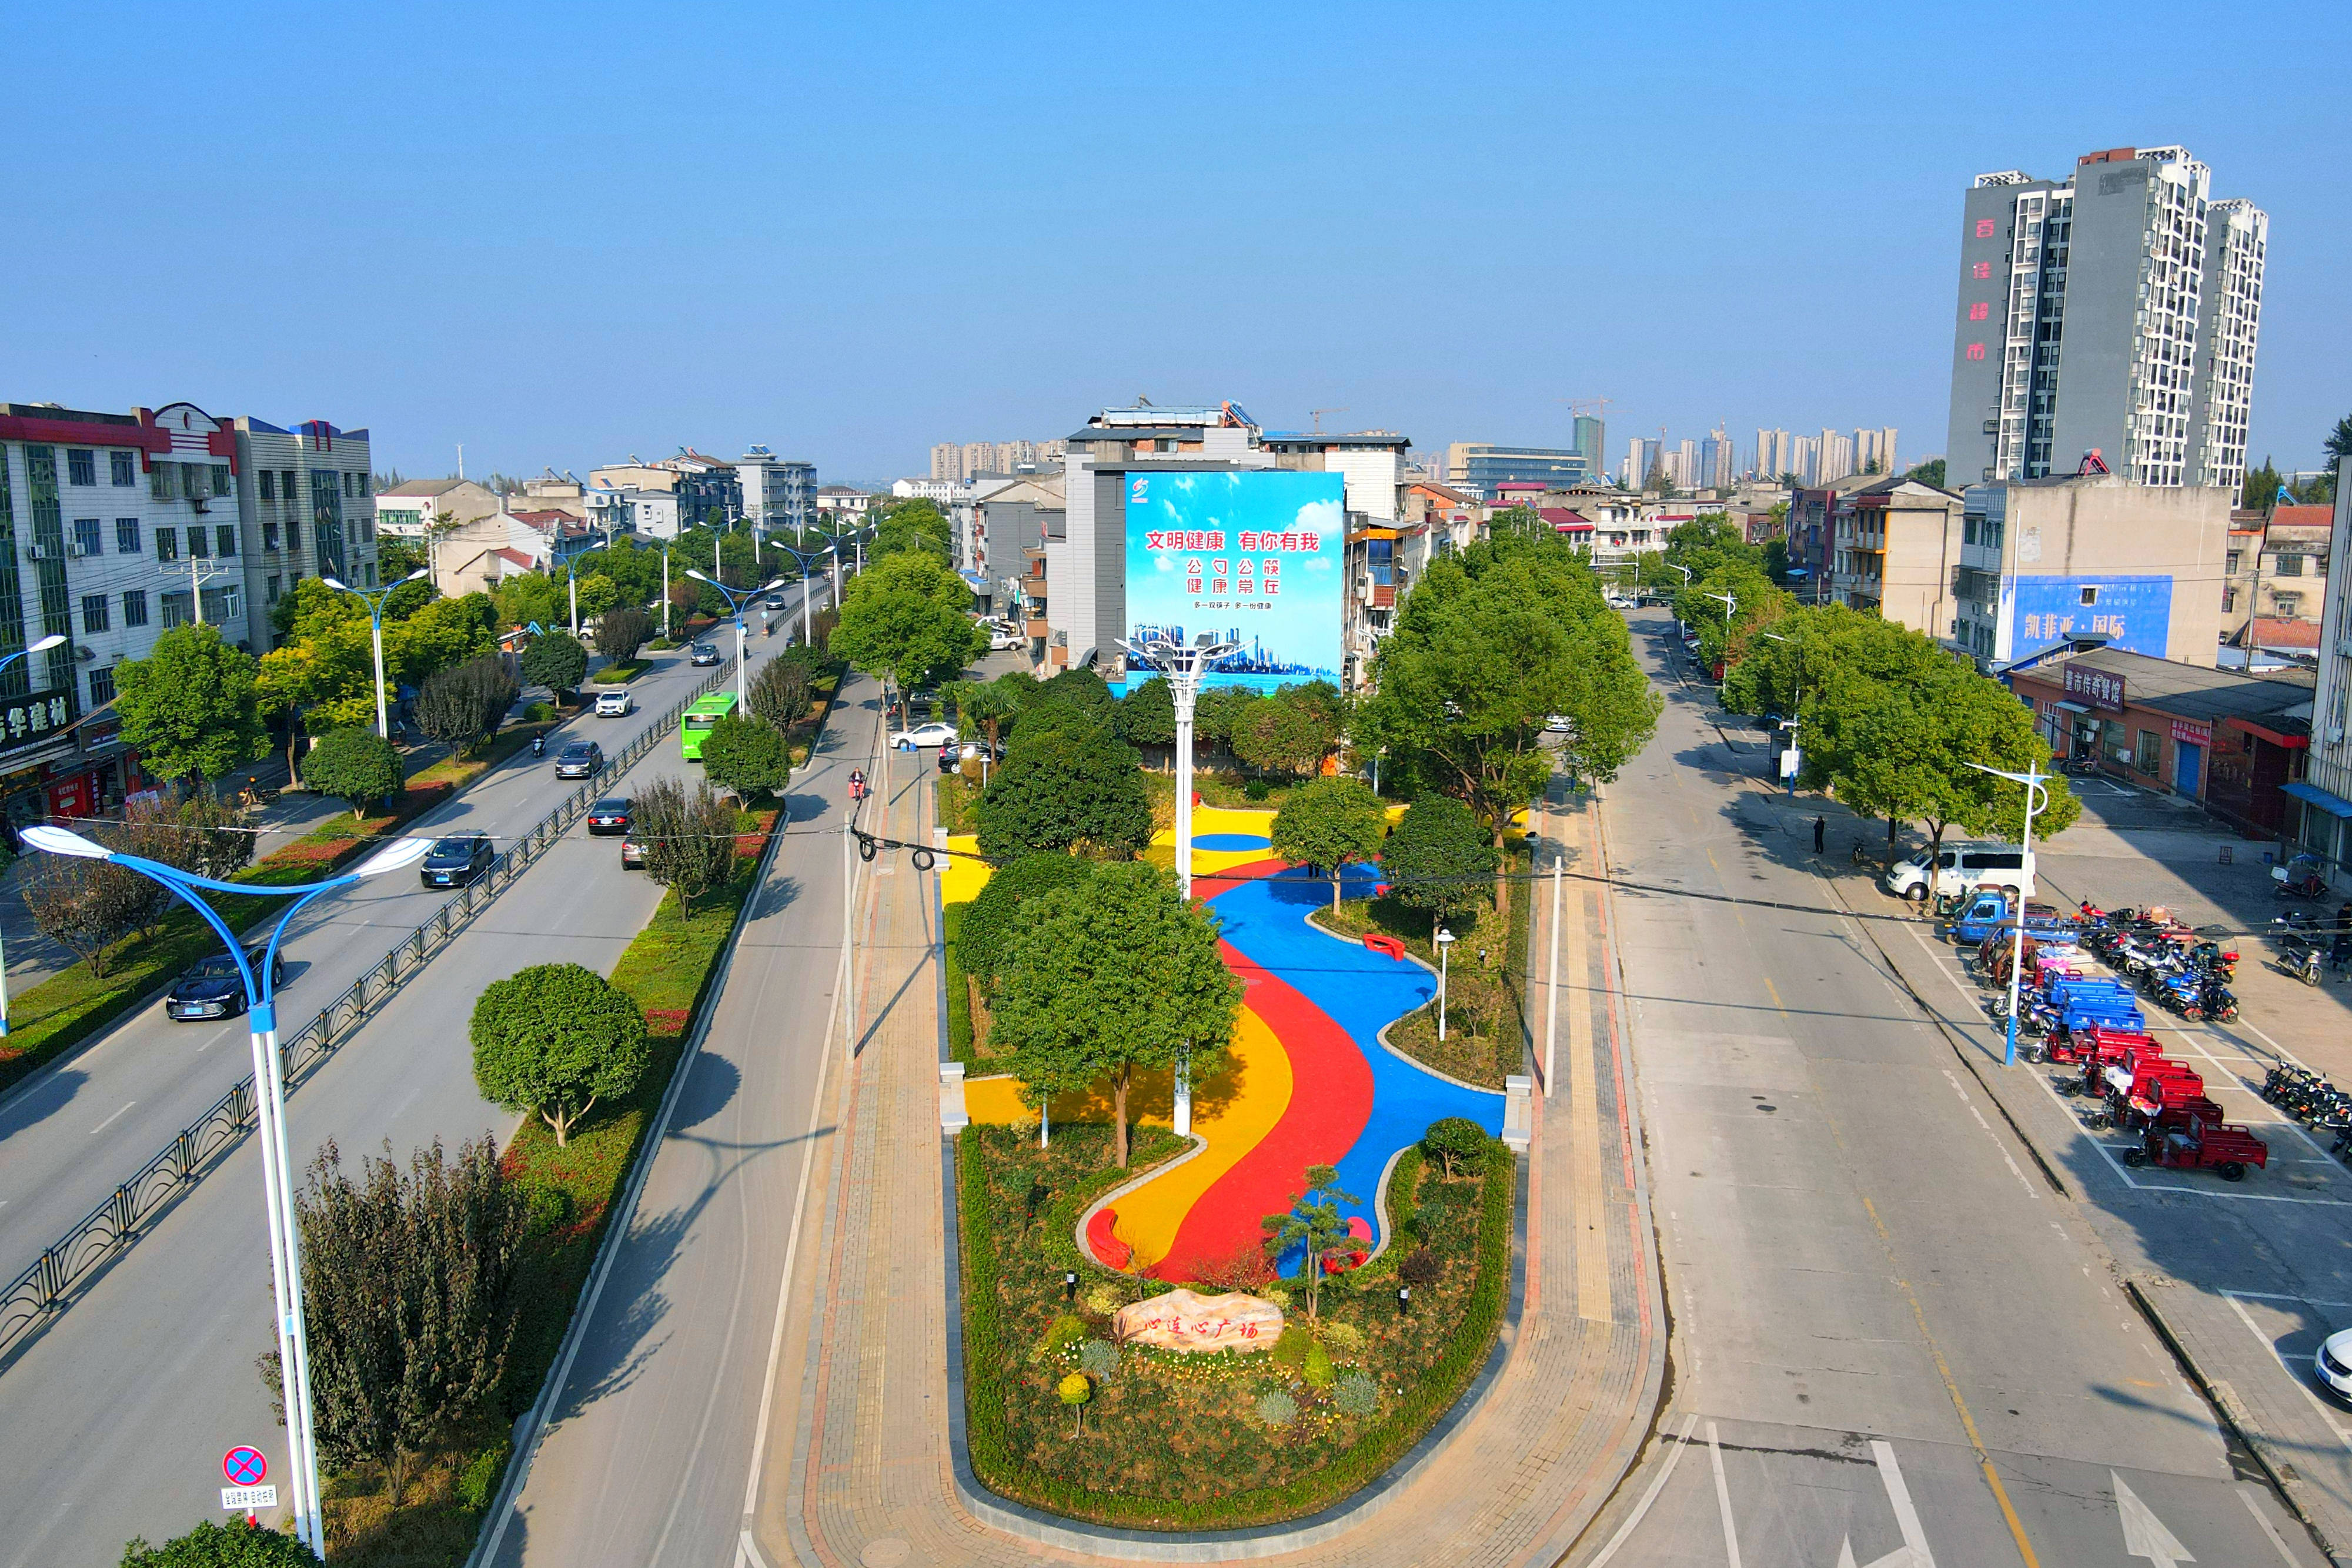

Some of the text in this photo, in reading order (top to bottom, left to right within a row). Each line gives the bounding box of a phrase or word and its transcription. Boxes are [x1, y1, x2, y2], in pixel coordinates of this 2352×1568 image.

[1145, 531, 1320, 551] 文明健康 有你有我
[1187, 559, 1280, 575] 公勺公筷
[1187, 579, 1280, 594] 健康常在
[1144, 1315, 1259, 1339] 心连心广场
